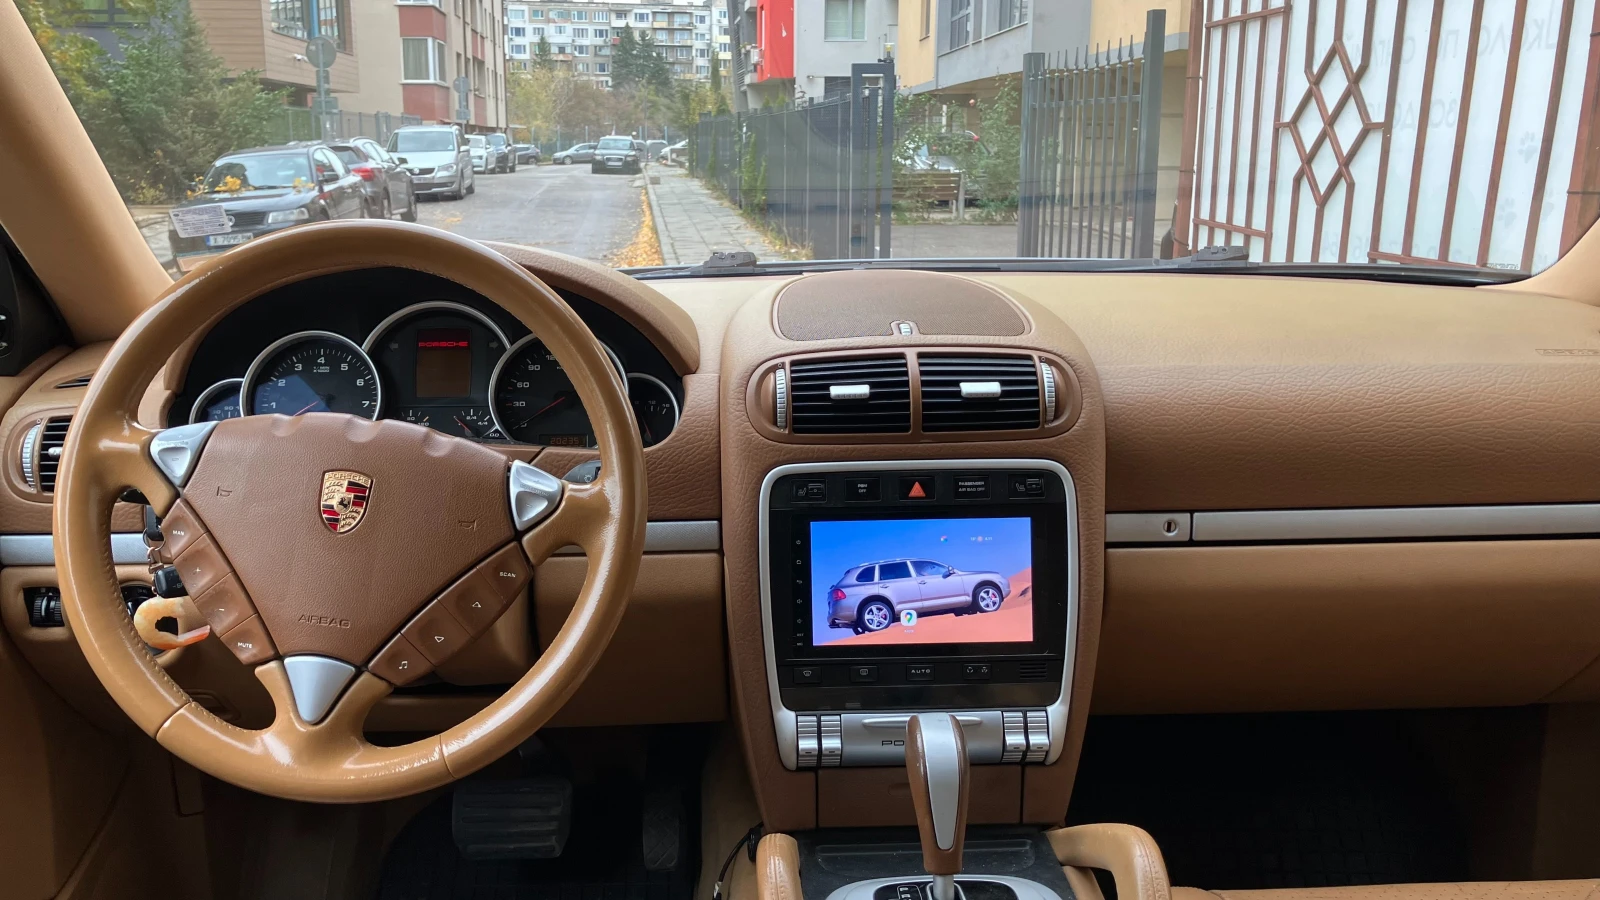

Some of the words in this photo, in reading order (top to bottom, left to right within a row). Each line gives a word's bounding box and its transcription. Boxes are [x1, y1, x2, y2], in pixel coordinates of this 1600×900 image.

[418, 340, 469, 348] PORSCHE
[317, 356, 326, 364] 4
[294, 363, 303, 371] 3
[340, 363, 349, 371] 5
[277, 378, 286, 387] 2
[356, 378, 364, 387] 6
[516, 381, 530, 389] 60
[270, 401, 277, 409] 1
[361, 400, 370, 408] 7
[325, 472, 371, 486] PORSCHE
[297, 613, 351, 628] AIRBAG
